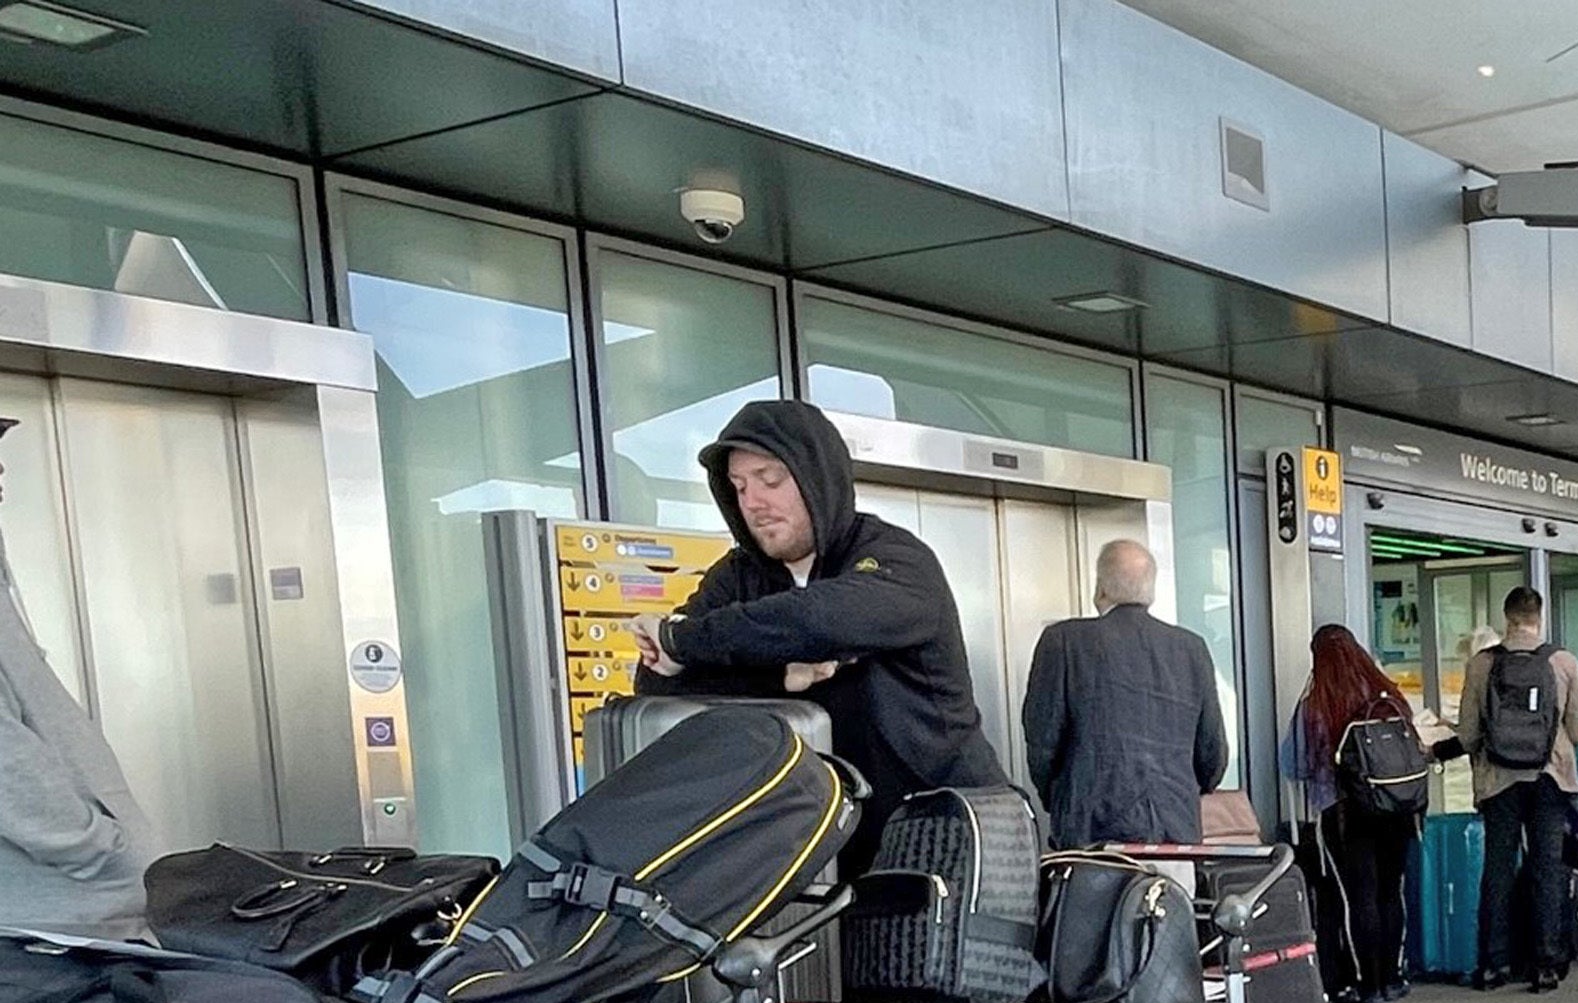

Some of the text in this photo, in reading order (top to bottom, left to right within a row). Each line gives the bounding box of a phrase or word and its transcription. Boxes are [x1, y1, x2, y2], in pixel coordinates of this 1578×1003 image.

[1460, 453, 1529, 490] Welcome
[1531, 469, 1547, 494] to
[1309, 483, 1337, 507] Help
[586, 537, 594, 549] 5
[588, 578, 598, 589] 4
[593, 627, 601, 637] 3
[596, 667, 605, 678] 2
